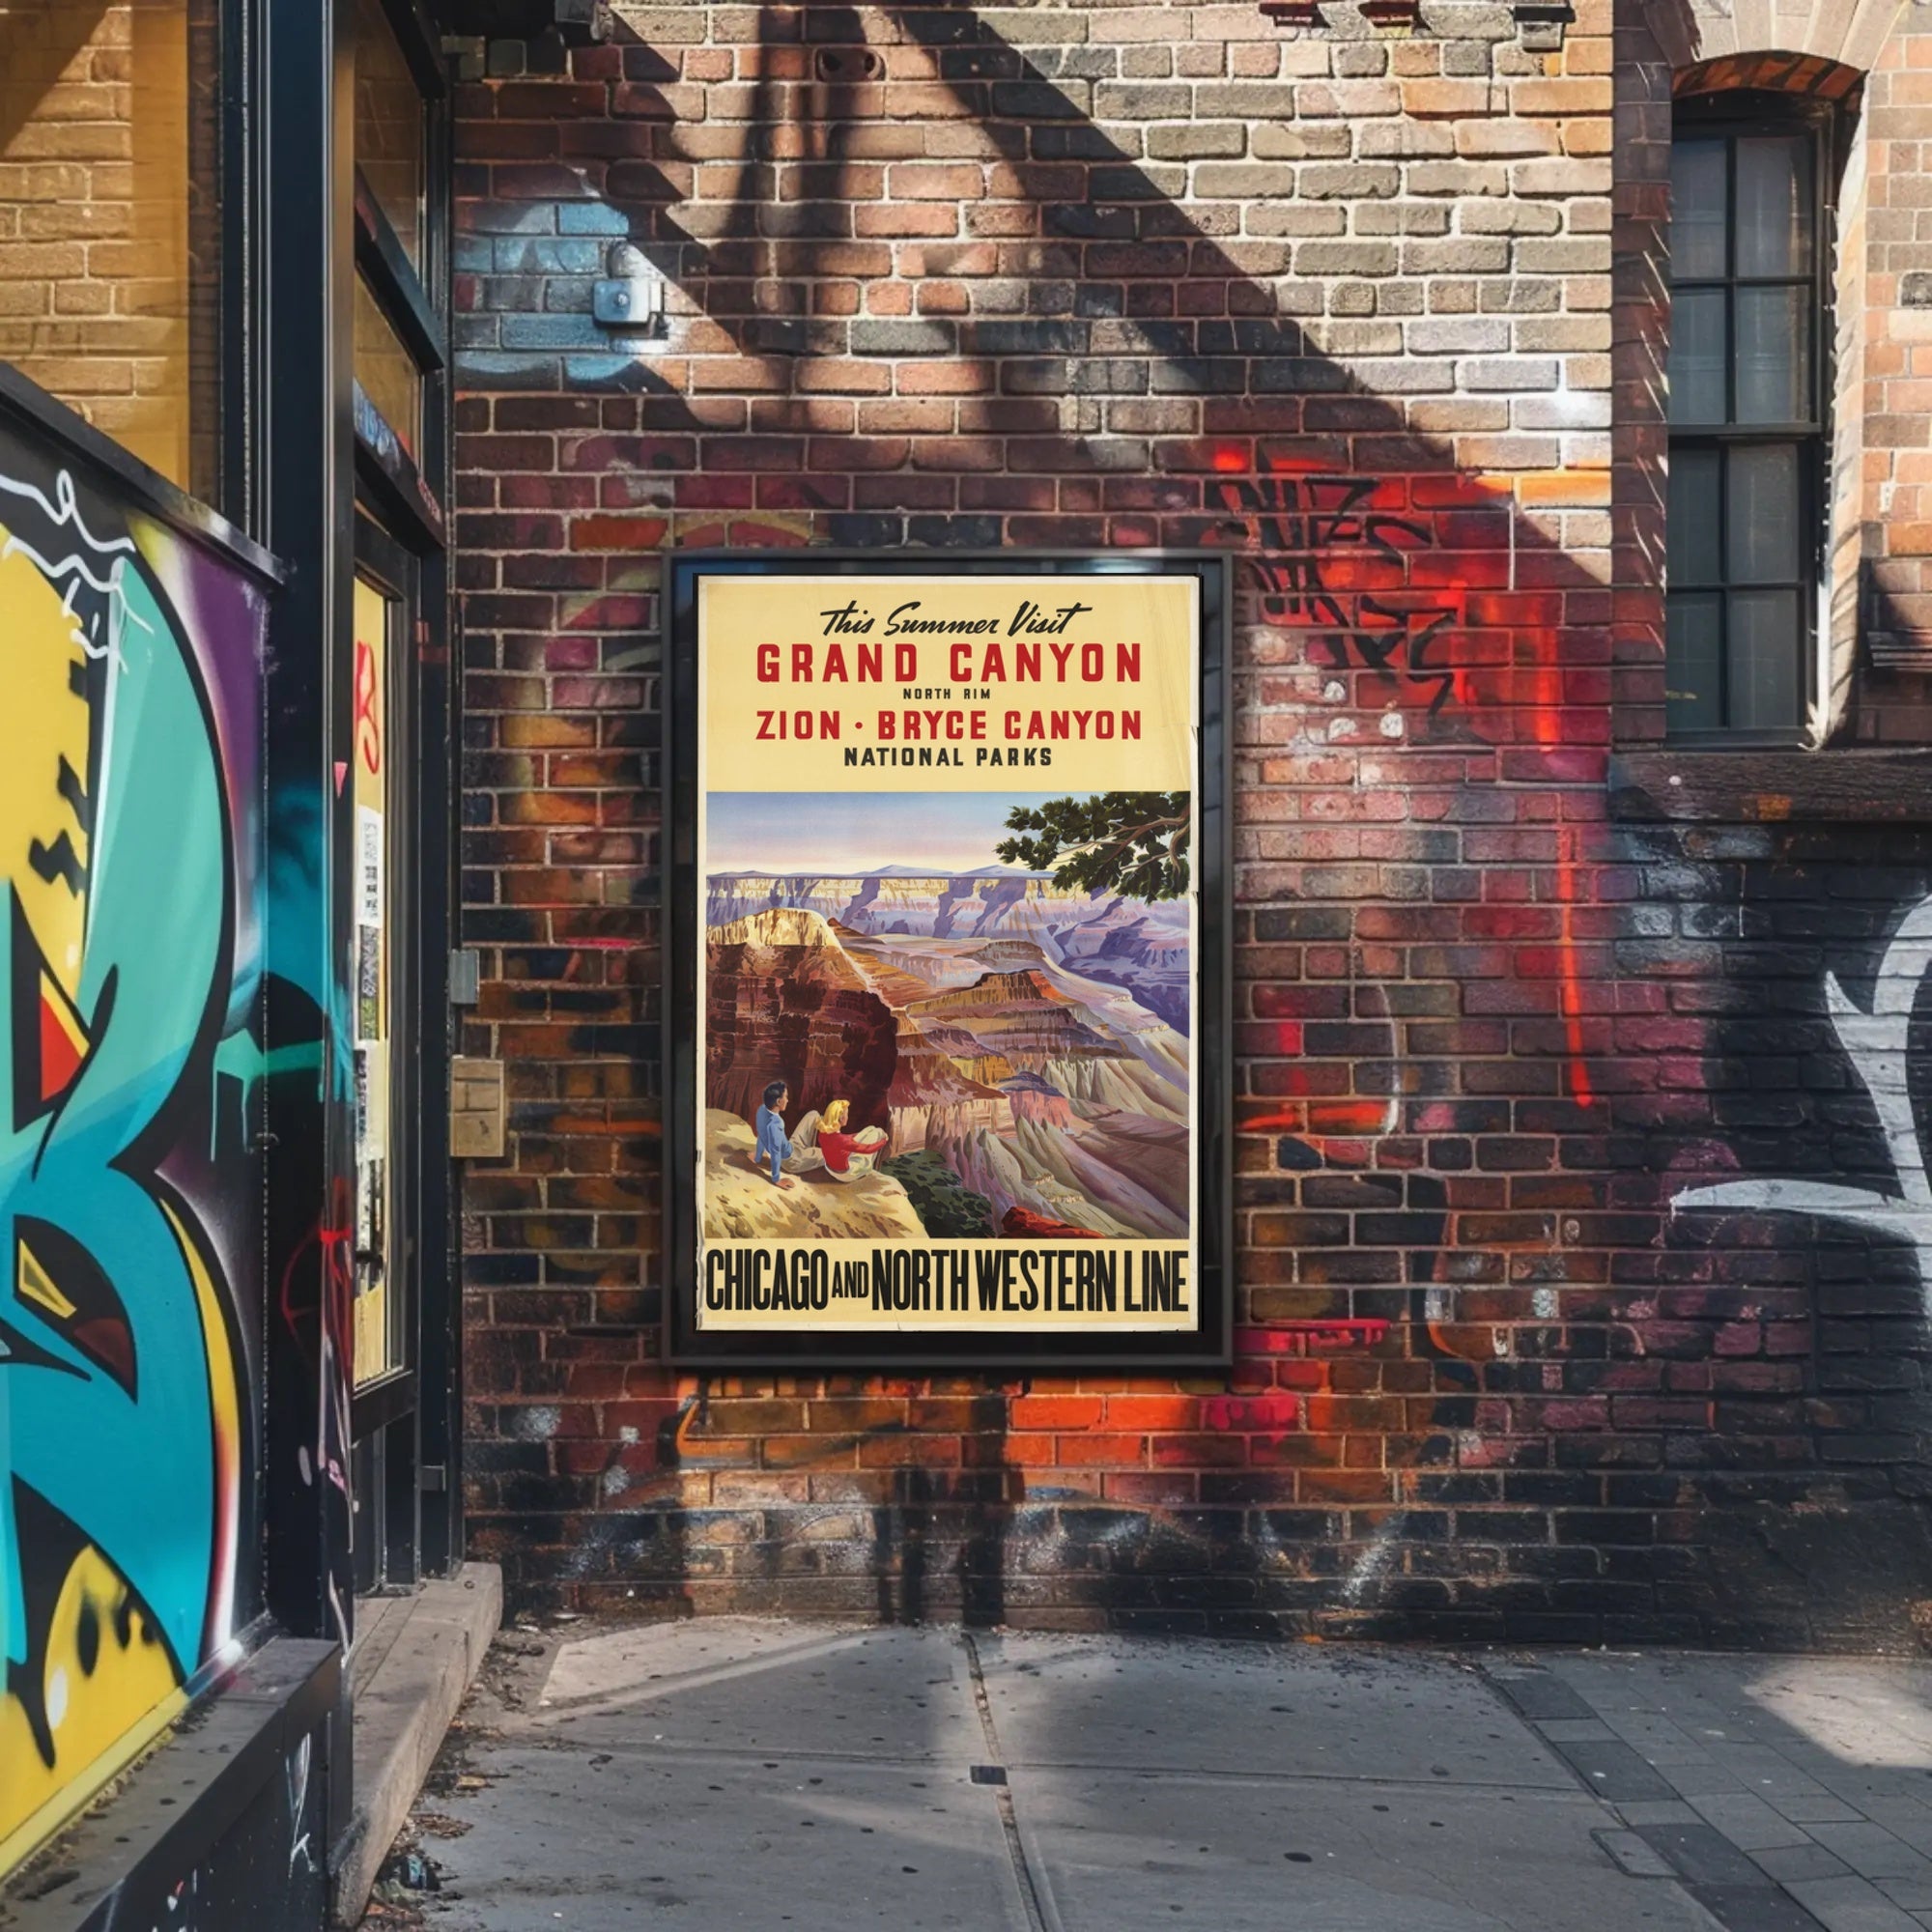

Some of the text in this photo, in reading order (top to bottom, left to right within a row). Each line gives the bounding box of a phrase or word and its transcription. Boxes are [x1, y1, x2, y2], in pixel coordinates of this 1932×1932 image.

[819, 600, 1094, 638] This Summer Visit
[756, 642, 1141, 683] GRAND CANYON
[903, 688, 991, 700] NORTH RIM
[755, 710, 840, 740] ZION
[878, 710, 986, 740] BRYCE
[1004, 710, 1141, 740] CANYON
[844, 747, 1052, 767] NATIONAL PARKS
[705, 1248, 1189, 1312] CHICAGO AND NORTH WESTERN LINE
